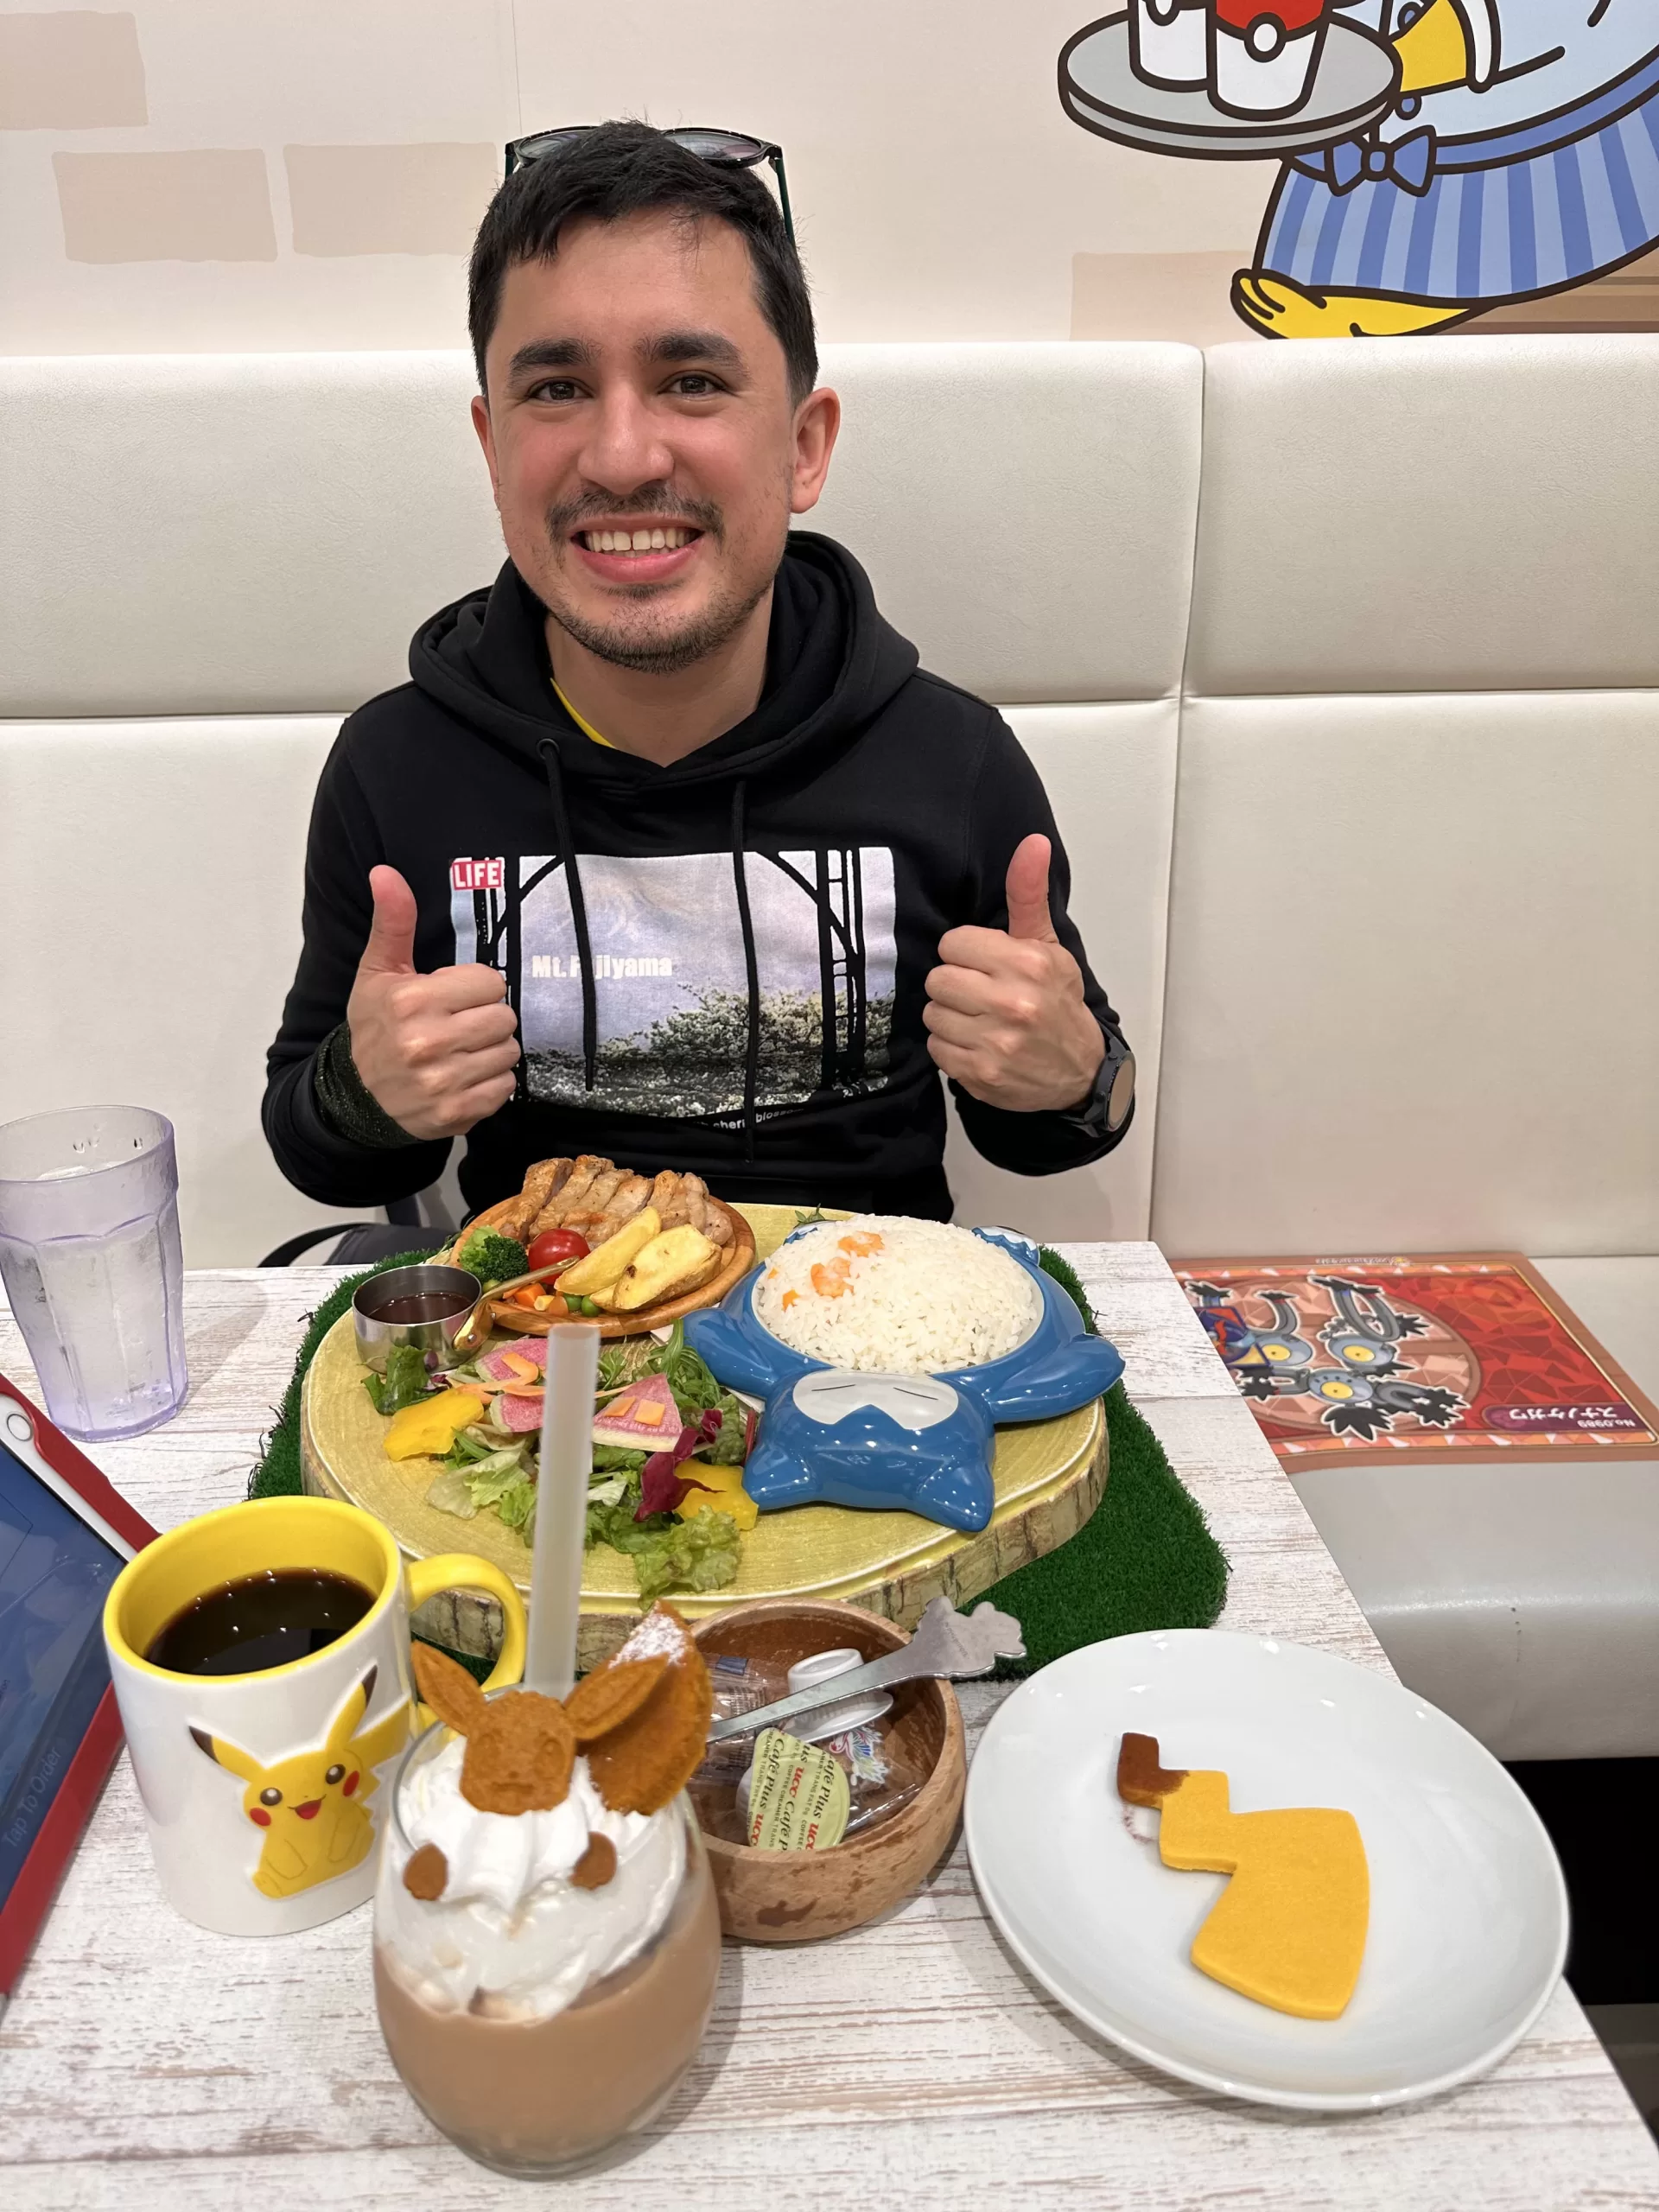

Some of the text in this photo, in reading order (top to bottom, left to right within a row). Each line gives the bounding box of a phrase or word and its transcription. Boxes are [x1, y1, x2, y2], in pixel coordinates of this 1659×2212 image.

[454, 862, 500, 887] LIFE
[532, 954, 672, 980] Mt. Fjiyama
[1509, 1407, 1618, 1420] スナノケガワ
[1577, 1419, 1636, 1428] No.0989
[768, 1738, 785, 1776] Café
[823, 1755, 835, 1785] afé
[783, 1764, 794, 1788] COFFEE
[789, 1767, 804, 1798] ucc
[810, 1771, 821, 1793] TRANS
[2, 1747, 61, 1847] Tap To Order
[760, 1775, 775, 1809] Plus
[773, 1790, 785, 1821] CREAMER
[805, 1794, 814, 1806] FAT
[813, 1785, 830, 1818] Plus
[751, 1813, 765, 1847] ucc
[779, 1801, 795, 1838] Café
[797, 1819, 807, 1846] COFFEE
[769, 1824, 779, 1847] TRANS
